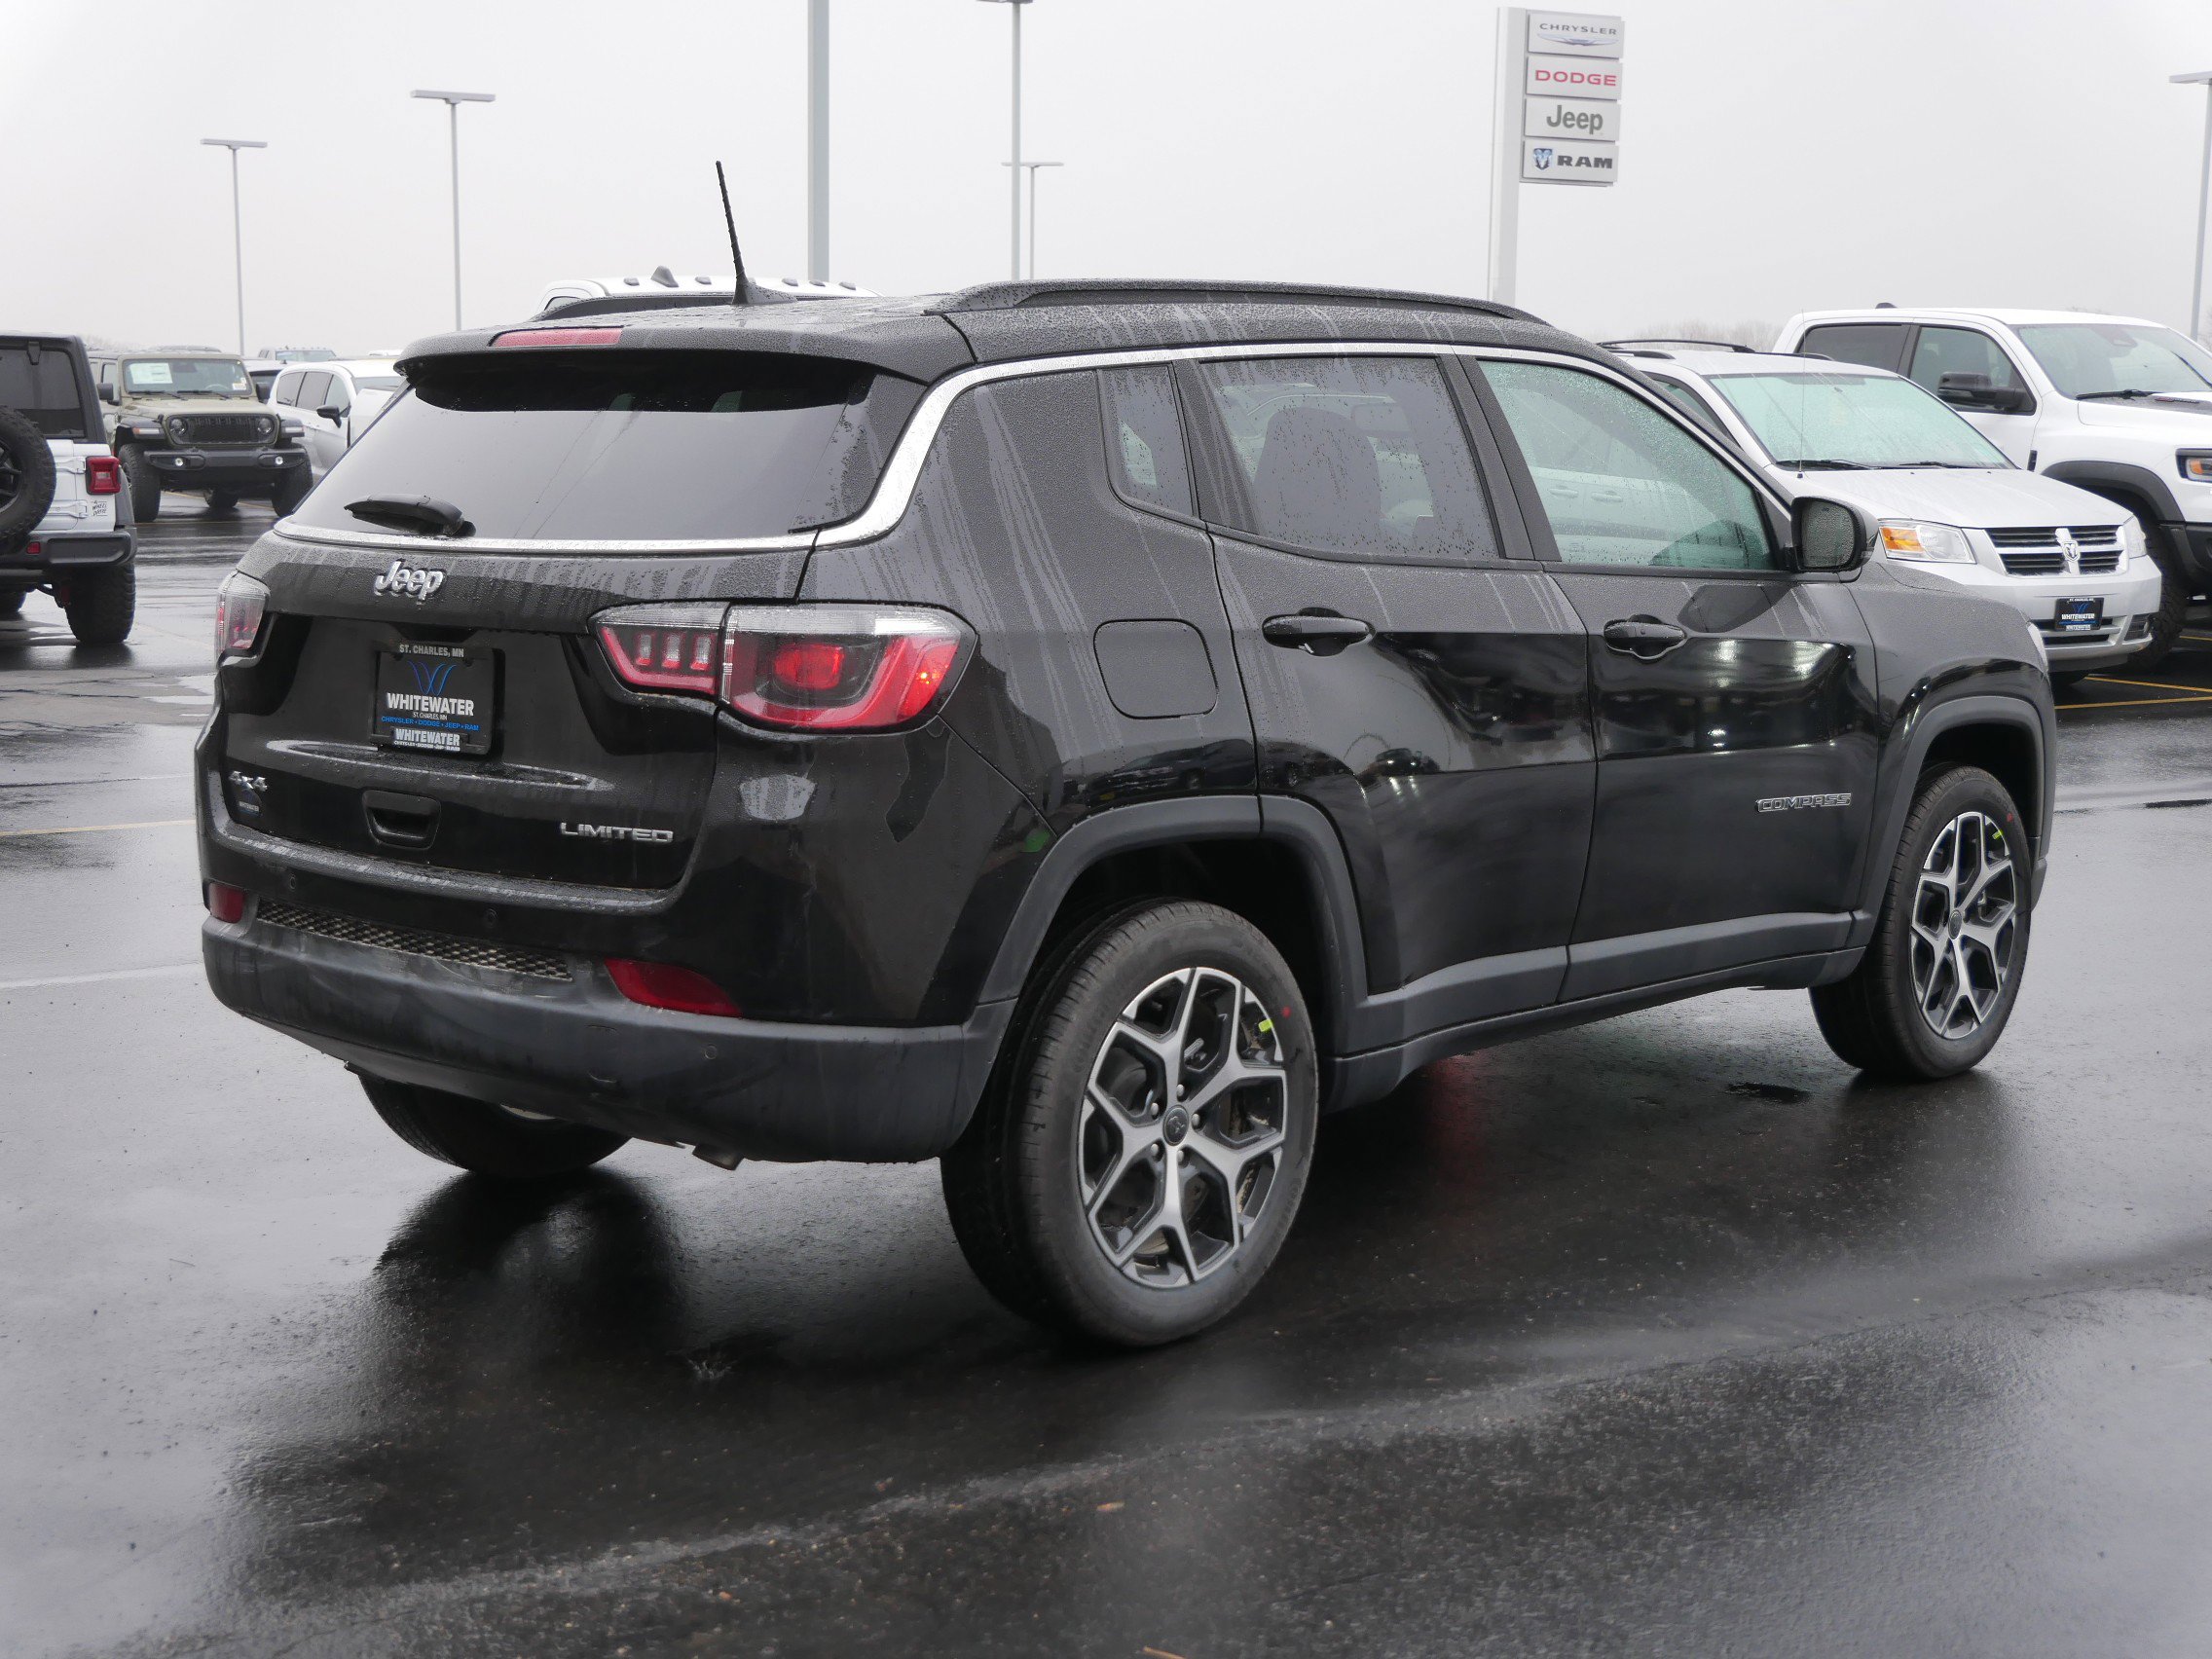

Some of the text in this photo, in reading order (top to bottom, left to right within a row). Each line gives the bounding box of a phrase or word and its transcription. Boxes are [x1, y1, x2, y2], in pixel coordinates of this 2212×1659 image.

[1539, 22, 1617, 35] CHRYSLER
[1535, 69, 1616, 87] DODGE
[1546, 104, 1604, 134] Jeep
[1558, 155, 1613, 168] RAM
[375, 561, 443, 601] Jeep
[399, 644, 464, 658] ST. CHARLES, MN
[387, 692, 475, 716] WHITEWATER
[381, 716, 415, 724] CHRYSLER
[395, 728, 461, 747] WHITEWATER
[1755, 793, 1852, 813] COMPASS
[561, 822, 674, 843] LIMITED
